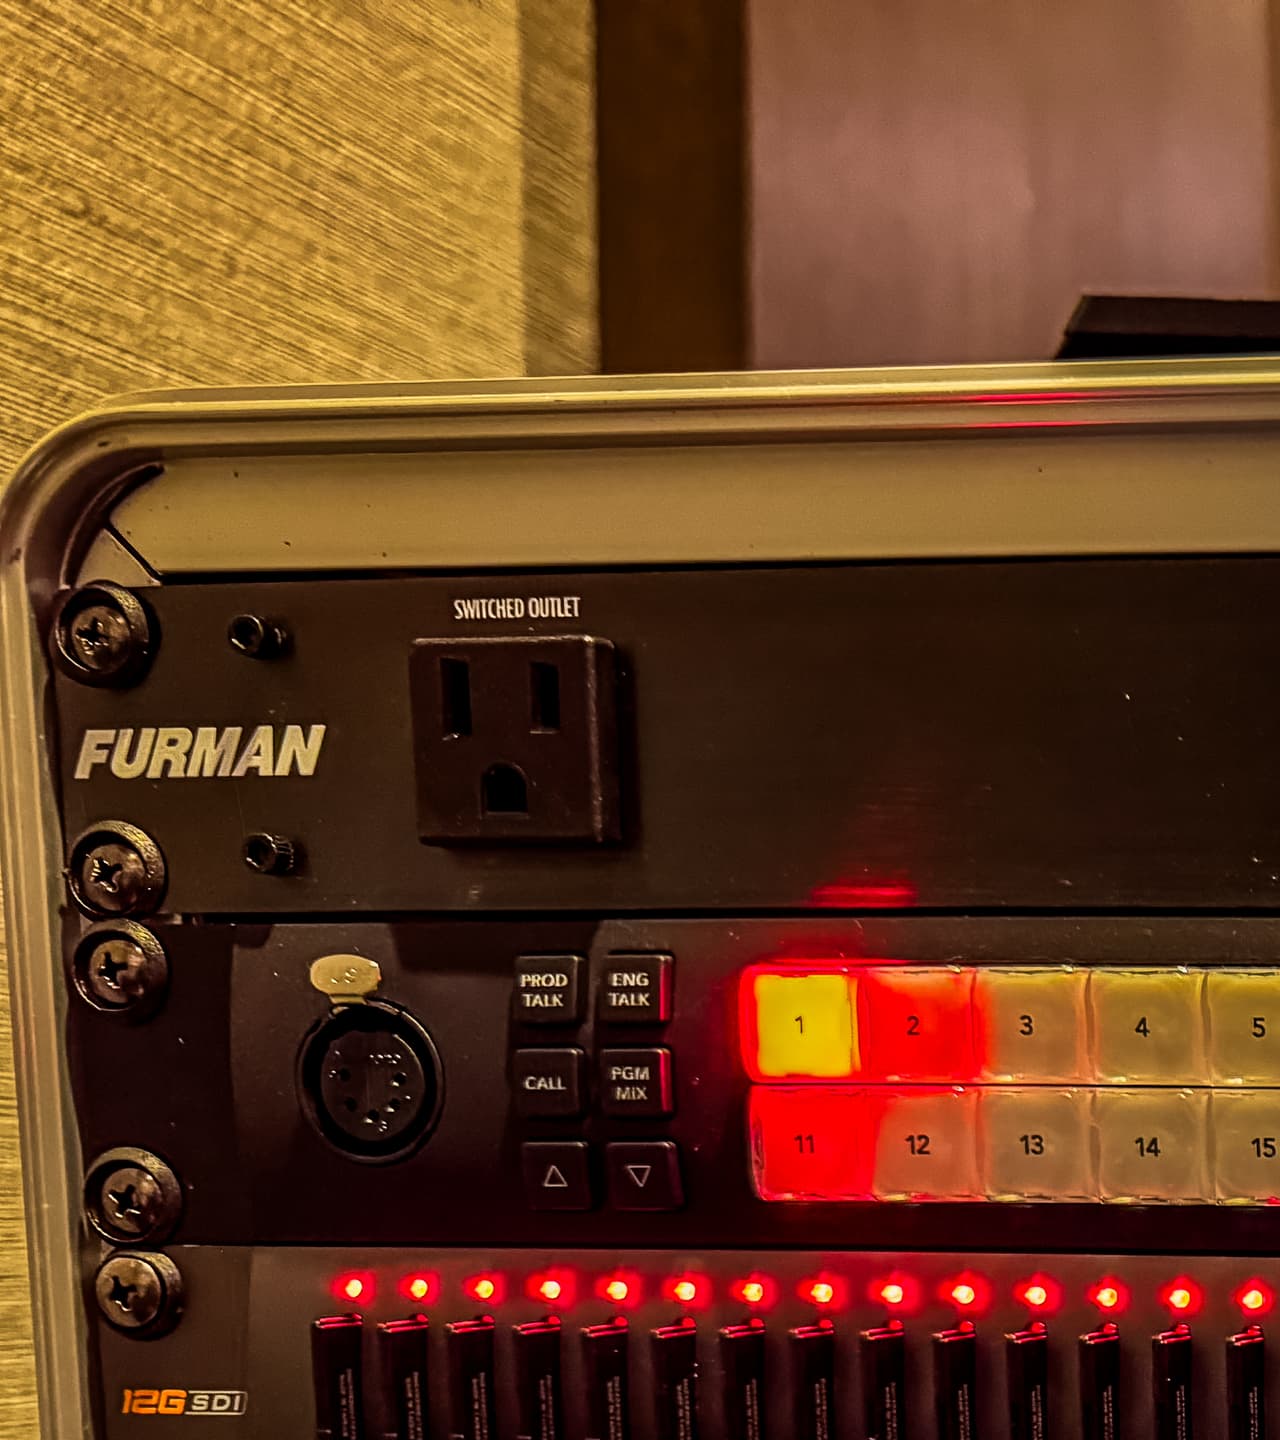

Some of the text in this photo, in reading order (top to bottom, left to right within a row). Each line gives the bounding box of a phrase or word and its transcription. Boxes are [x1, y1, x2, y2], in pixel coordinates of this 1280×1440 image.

[454, 597, 580, 619] SWITCHED OUTLET
[75, 725, 325, 778] FURMAN
[520, 973, 568, 988] PROD
[611, 972, 649, 987] ENG
[522, 993, 564, 1007] TALK
[608, 991, 651, 1008] TALK
[794, 1014, 804, 1035] 1
[906, 1016, 920, 1037] 2
[1020, 1015, 1033, 1035] 3
[1135, 1017, 1150, 1037] 4
[1253, 1018, 1265, 1037] 5
[524, 1075, 567, 1090] CALL
[611, 1066, 650, 1081] PGM
[615, 1086, 648, 1100] MIX
[794, 1134, 816, 1155] 11
[905, 1135, 930, 1154] 12
[1020, 1135, 1043, 1154] 13
[1135, 1138, 1160, 1157] 14
[1252, 1138, 1276, 1157] 15
[123, 1389, 240, 1415] 12G SDI
